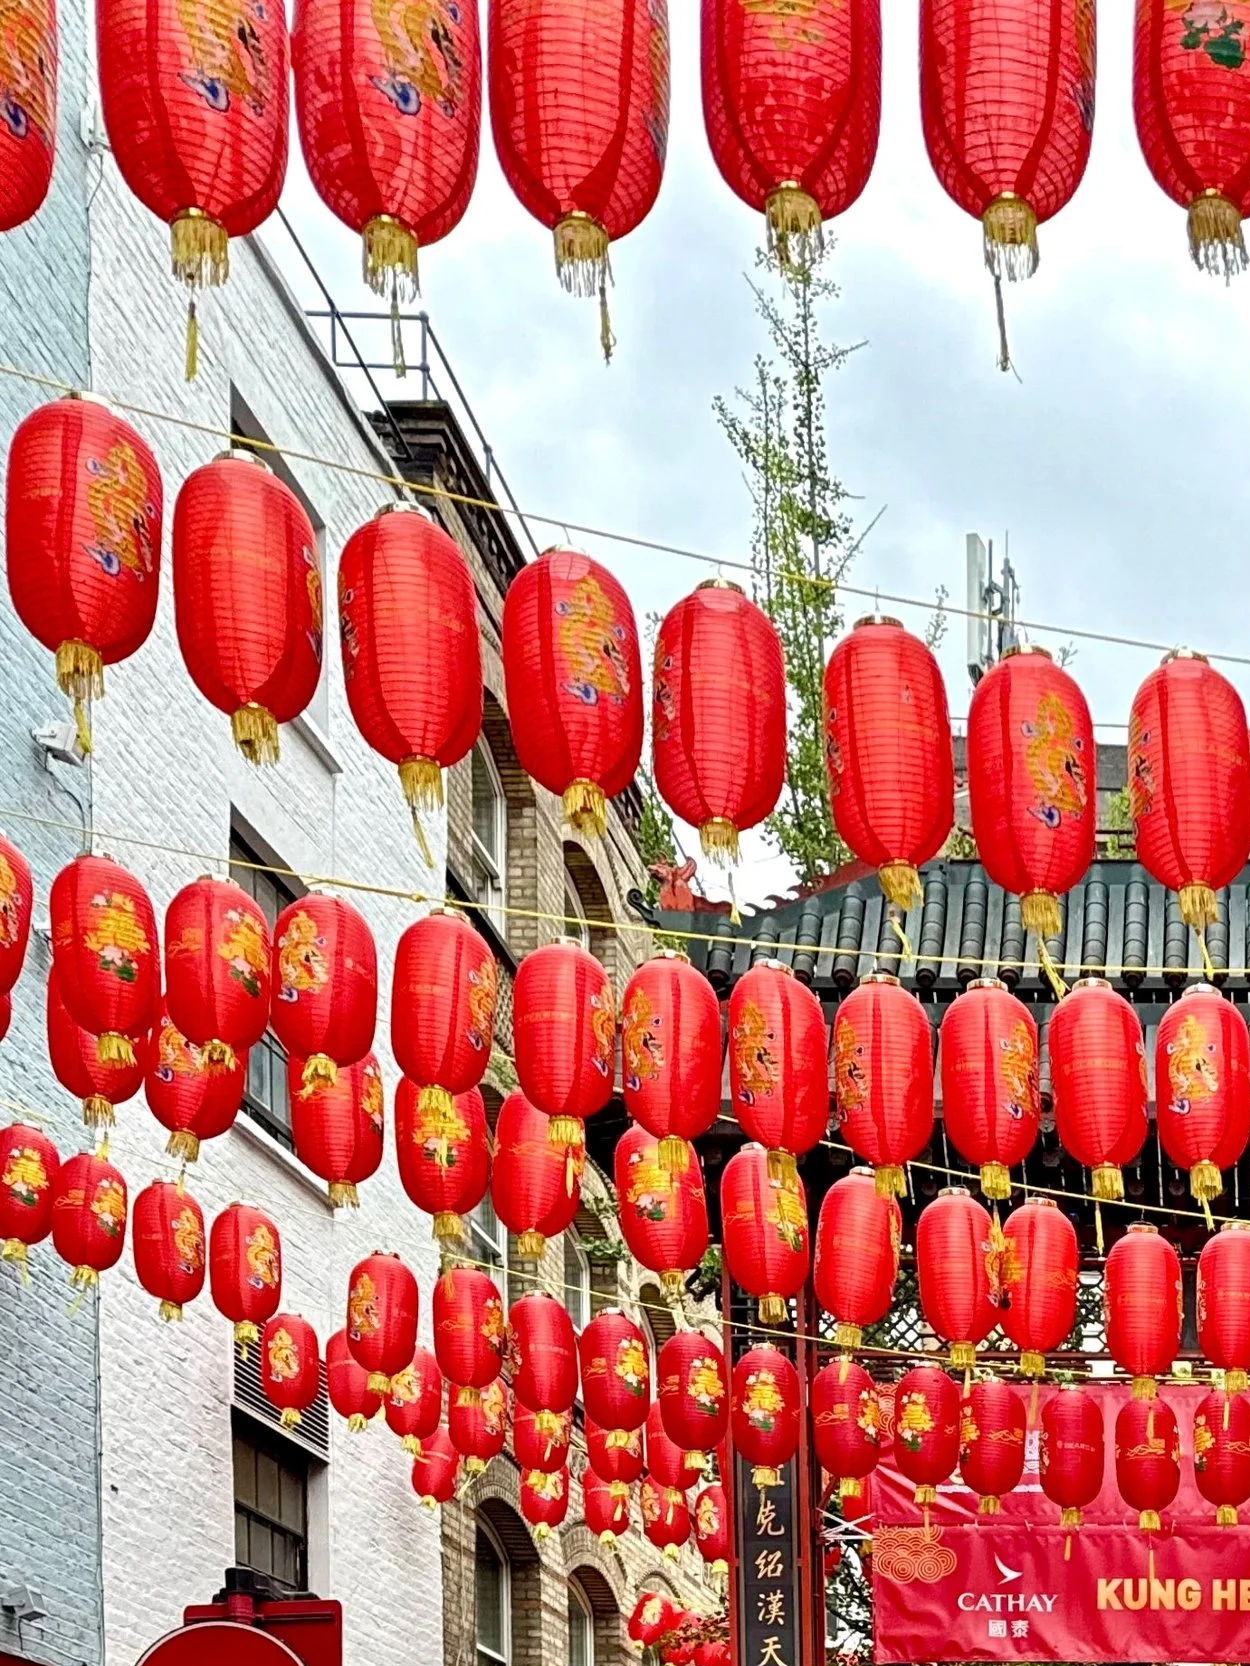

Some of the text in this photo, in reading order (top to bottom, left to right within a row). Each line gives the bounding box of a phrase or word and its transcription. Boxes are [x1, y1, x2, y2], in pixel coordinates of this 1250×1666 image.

[957, 1592, 1059, 1612] CATHAY
[1097, 1578, 1202, 1611] KUNG
[988, 1619, 1029, 1638] 國泰
